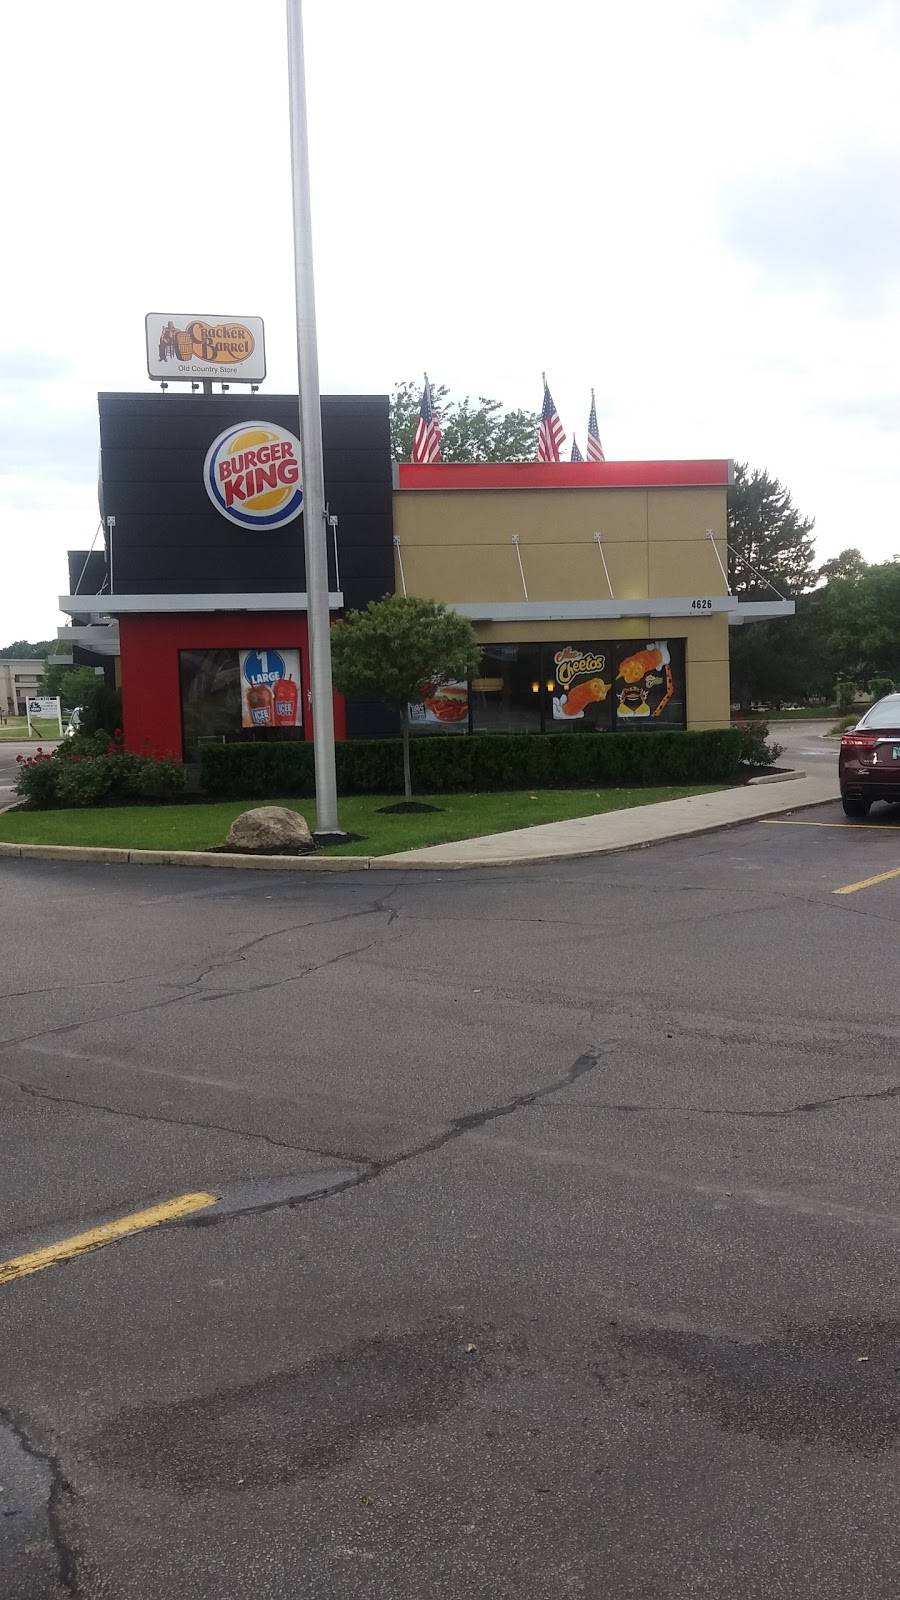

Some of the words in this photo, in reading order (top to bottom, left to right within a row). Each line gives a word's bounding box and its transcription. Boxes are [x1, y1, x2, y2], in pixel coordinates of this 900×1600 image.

[191, 323, 246, 345] Cracker
[201, 337, 249, 361] Barrel
[178, 365, 190, 373] Old
[191, 365, 218, 375] Country
[220, 366, 238, 374] Store
[218, 441, 295, 482] BURGER
[224, 458, 299, 507] KING
[691, 599, 712, 609] 4626
[256, 651, 269, 673] 1
[558, 654, 604, 683] Cheetos
[250, 671, 281, 685] LARGE
